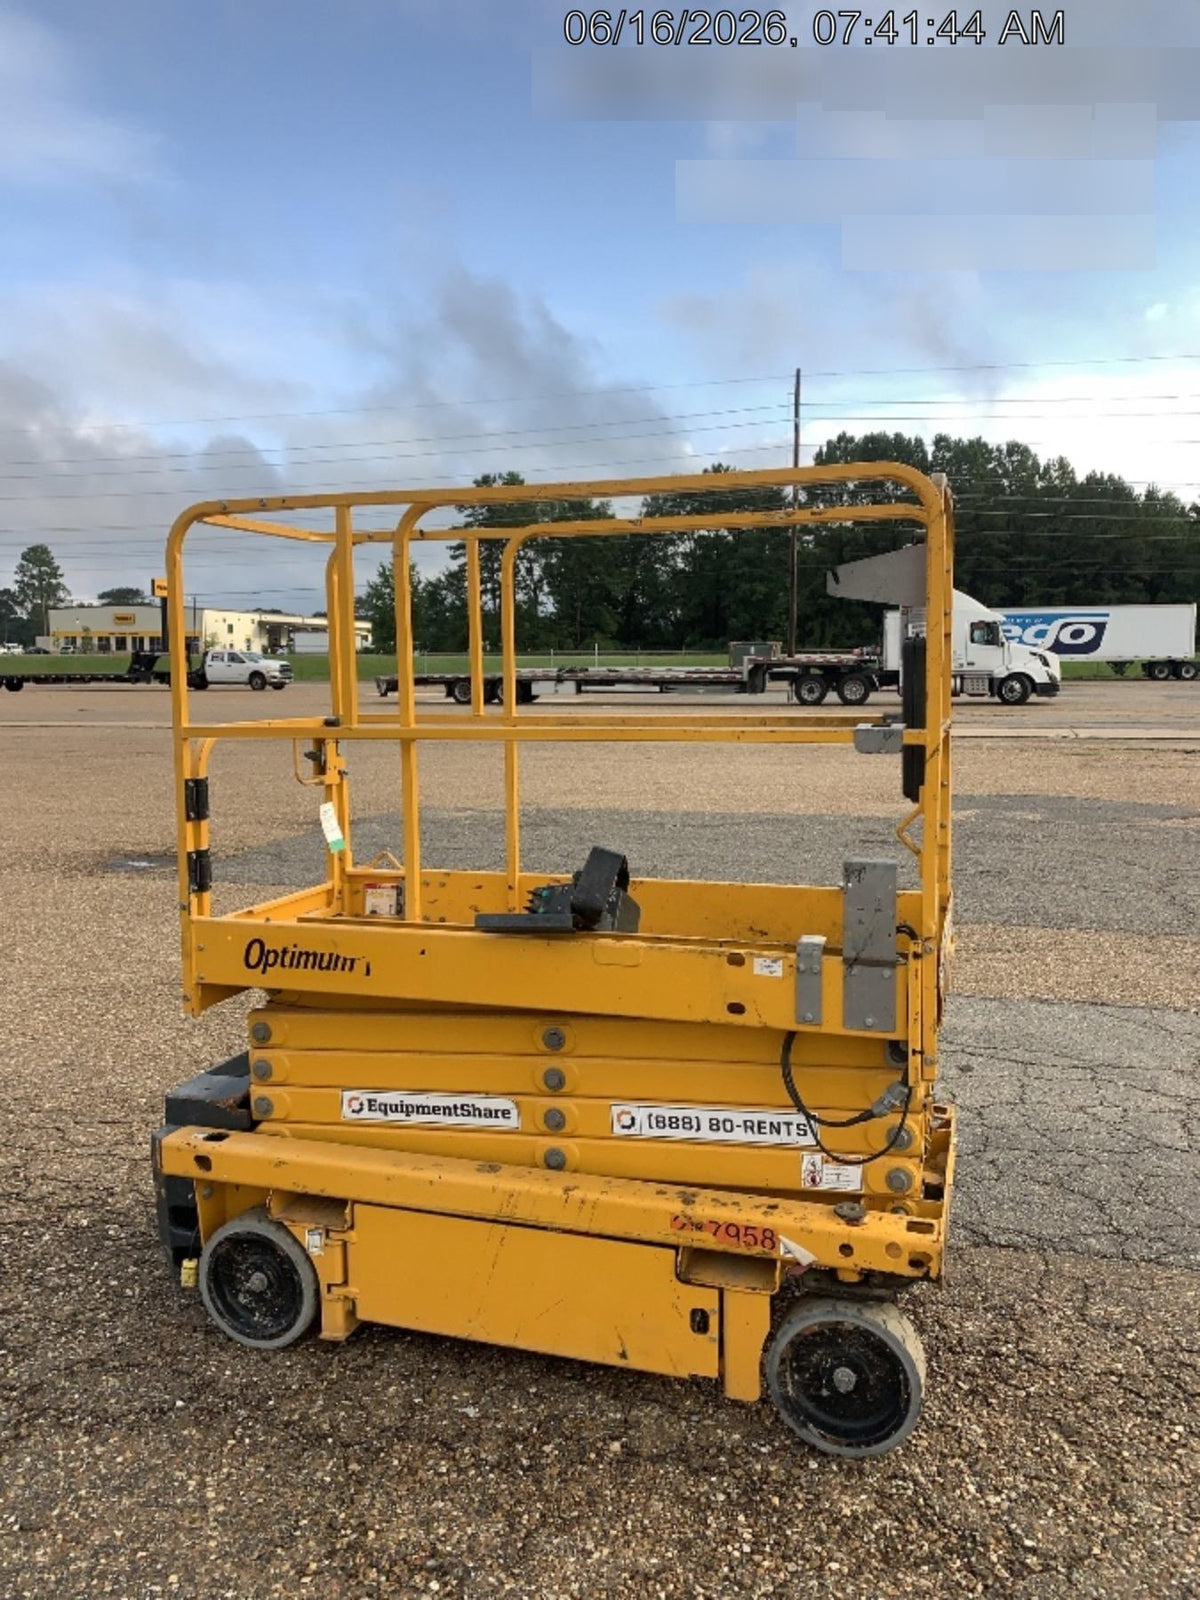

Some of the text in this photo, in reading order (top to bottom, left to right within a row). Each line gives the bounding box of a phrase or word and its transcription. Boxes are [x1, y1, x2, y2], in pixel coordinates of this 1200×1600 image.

[244, 938, 356, 975] Optimum
[366, 1098, 512, 1120] EquipmentShare
[647, 1108, 809, 1137] (888) 80-RENTS
